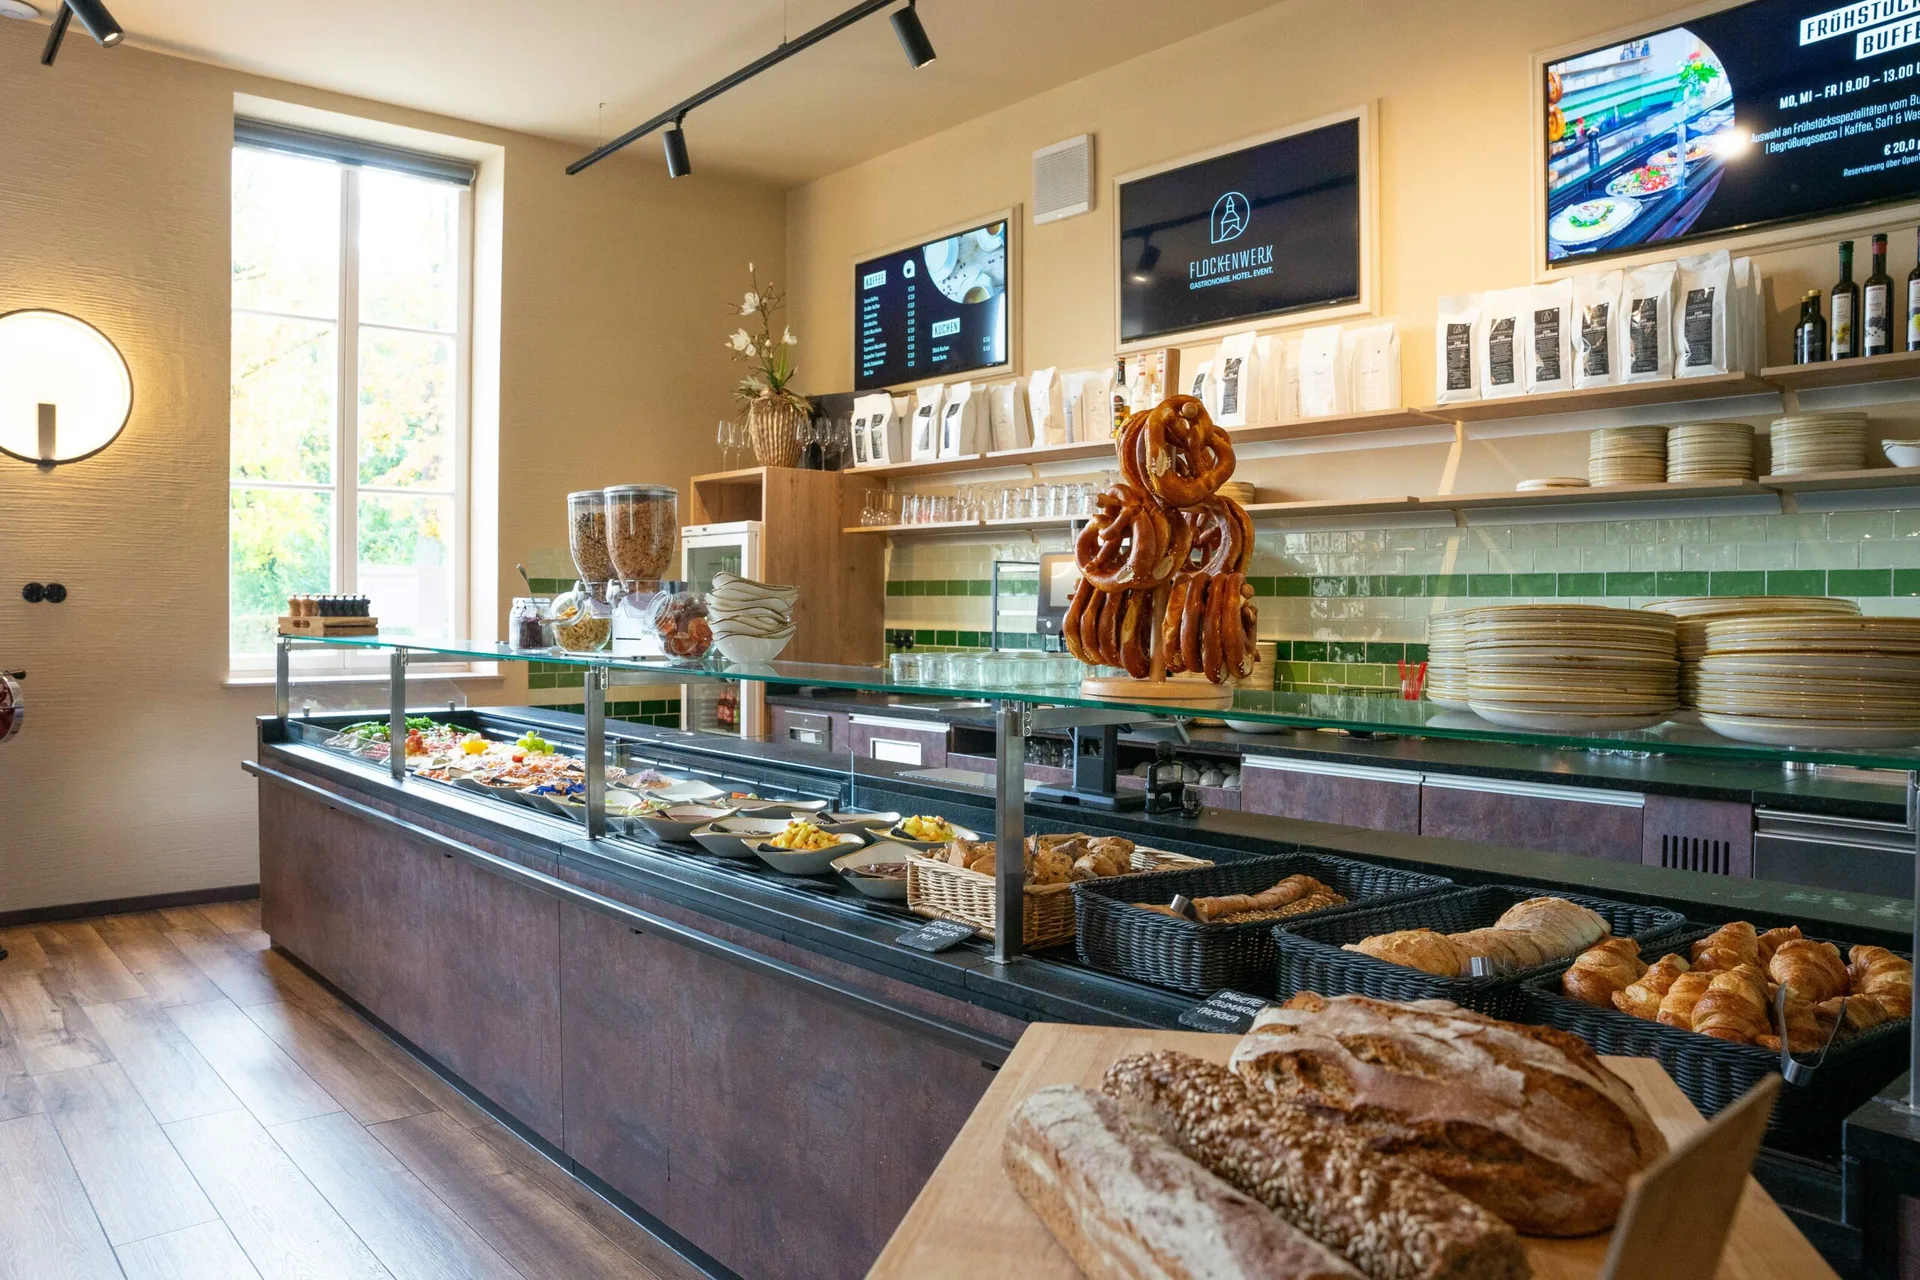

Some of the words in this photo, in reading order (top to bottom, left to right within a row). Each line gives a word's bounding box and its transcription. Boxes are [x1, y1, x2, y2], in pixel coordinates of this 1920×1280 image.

[1779, 95, 1798, 109] MO,
[1799, 90, 1813, 105] MI
[1824, 84, 1838, 98] FR
[1883, 64, 1913, 83] 13.00
[1750, 127, 1782, 143] Auswahl
[1782, 126, 1792, 136] an
[1889, 99, 1908, 111] vom
[1770, 130, 1838, 153] Begrüßungssecco
[1844, 121, 1874, 136] Kaffee,
[1875, 115, 1894, 129] Saft
[1895, 112, 1903, 124] &
[1843, 162, 1885, 177] Reservierung
[1885, 158, 1901, 169] über
[1189, 244, 1273, 279] FLOCKENWERK
[1189, 275, 1232, 290] GASTRONOMIE.
[1232, 271, 1253, 282] HOTEL.
[1253, 266, 1274, 277] EVENT.
[934, 320, 958, 336] KUCHEN
[917, 933, 939, 941] MIX
